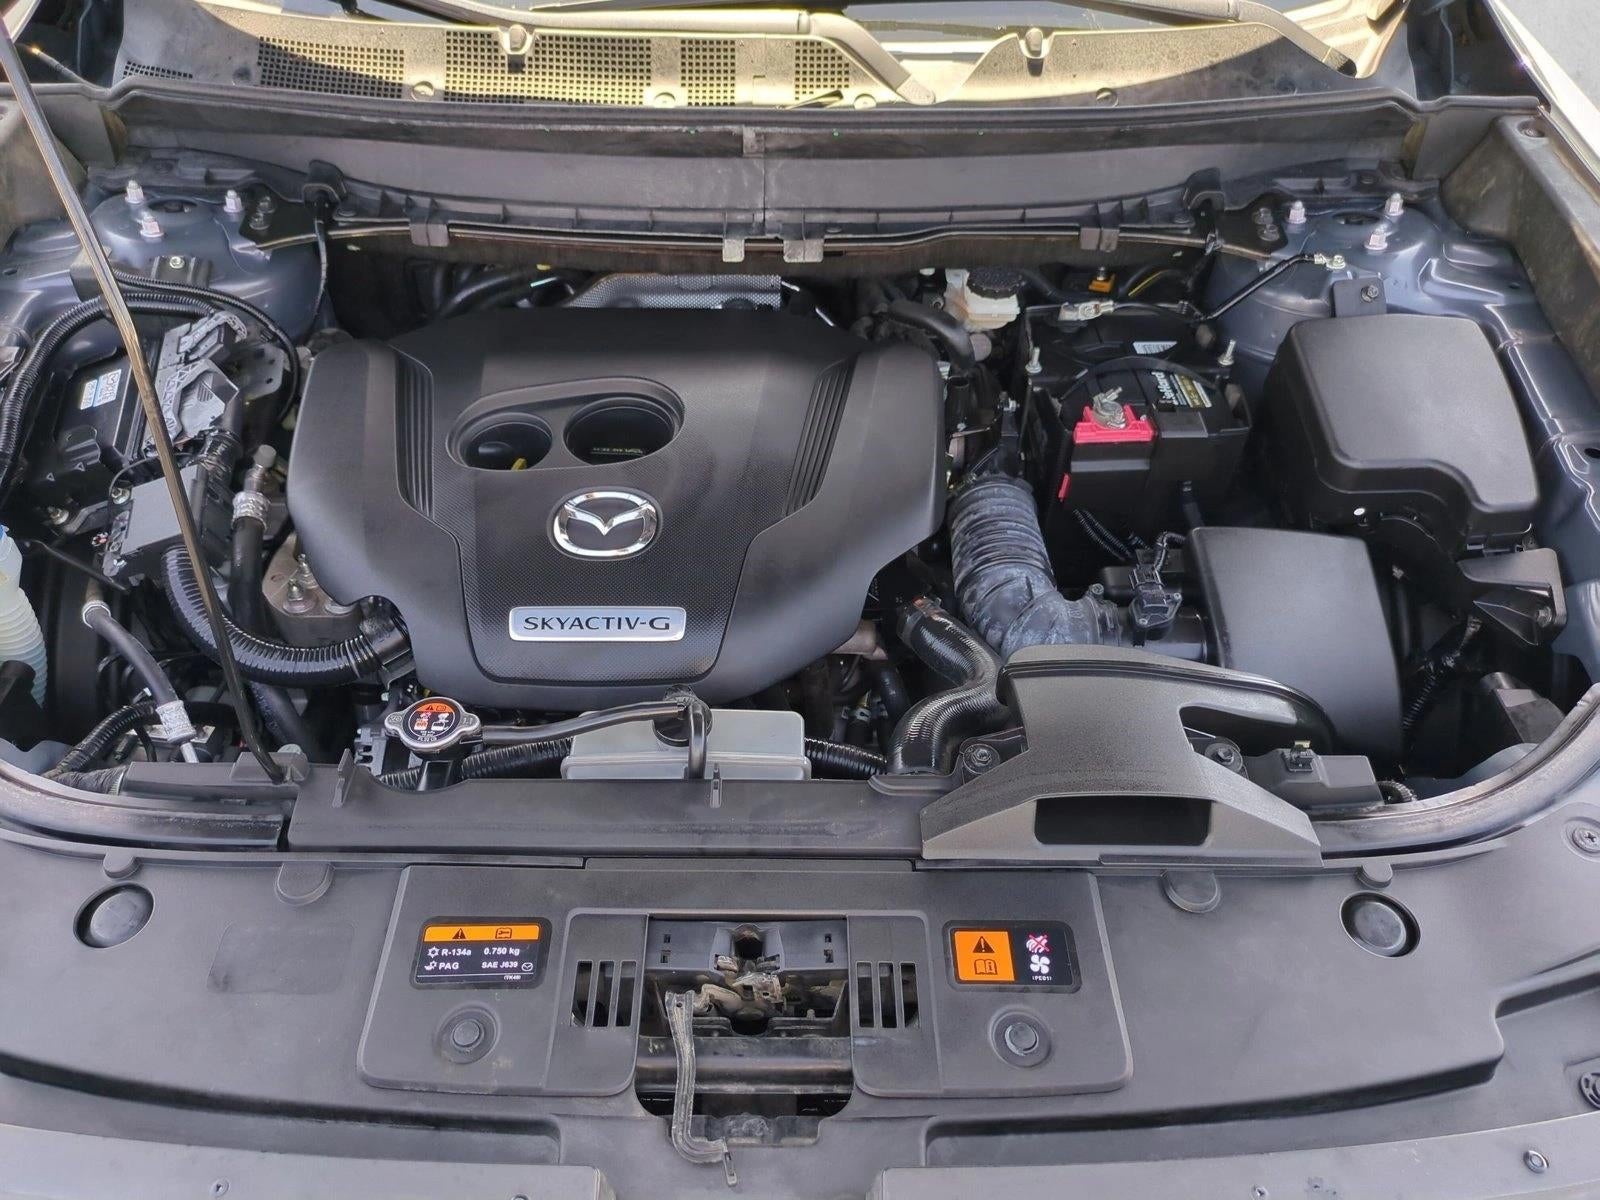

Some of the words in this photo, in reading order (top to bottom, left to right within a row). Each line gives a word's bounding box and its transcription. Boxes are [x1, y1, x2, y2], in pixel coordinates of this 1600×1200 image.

[523, 616, 671, 631] SKYACTIV-G
[441, 948, 472, 957] R-134a
[483, 947, 507, 956] 0.750
[508, 947, 520, 956] kg
[438, 962, 460, 970] PAG
[481, 961, 498, 969] SAE
[500, 961, 518, 969] J639
